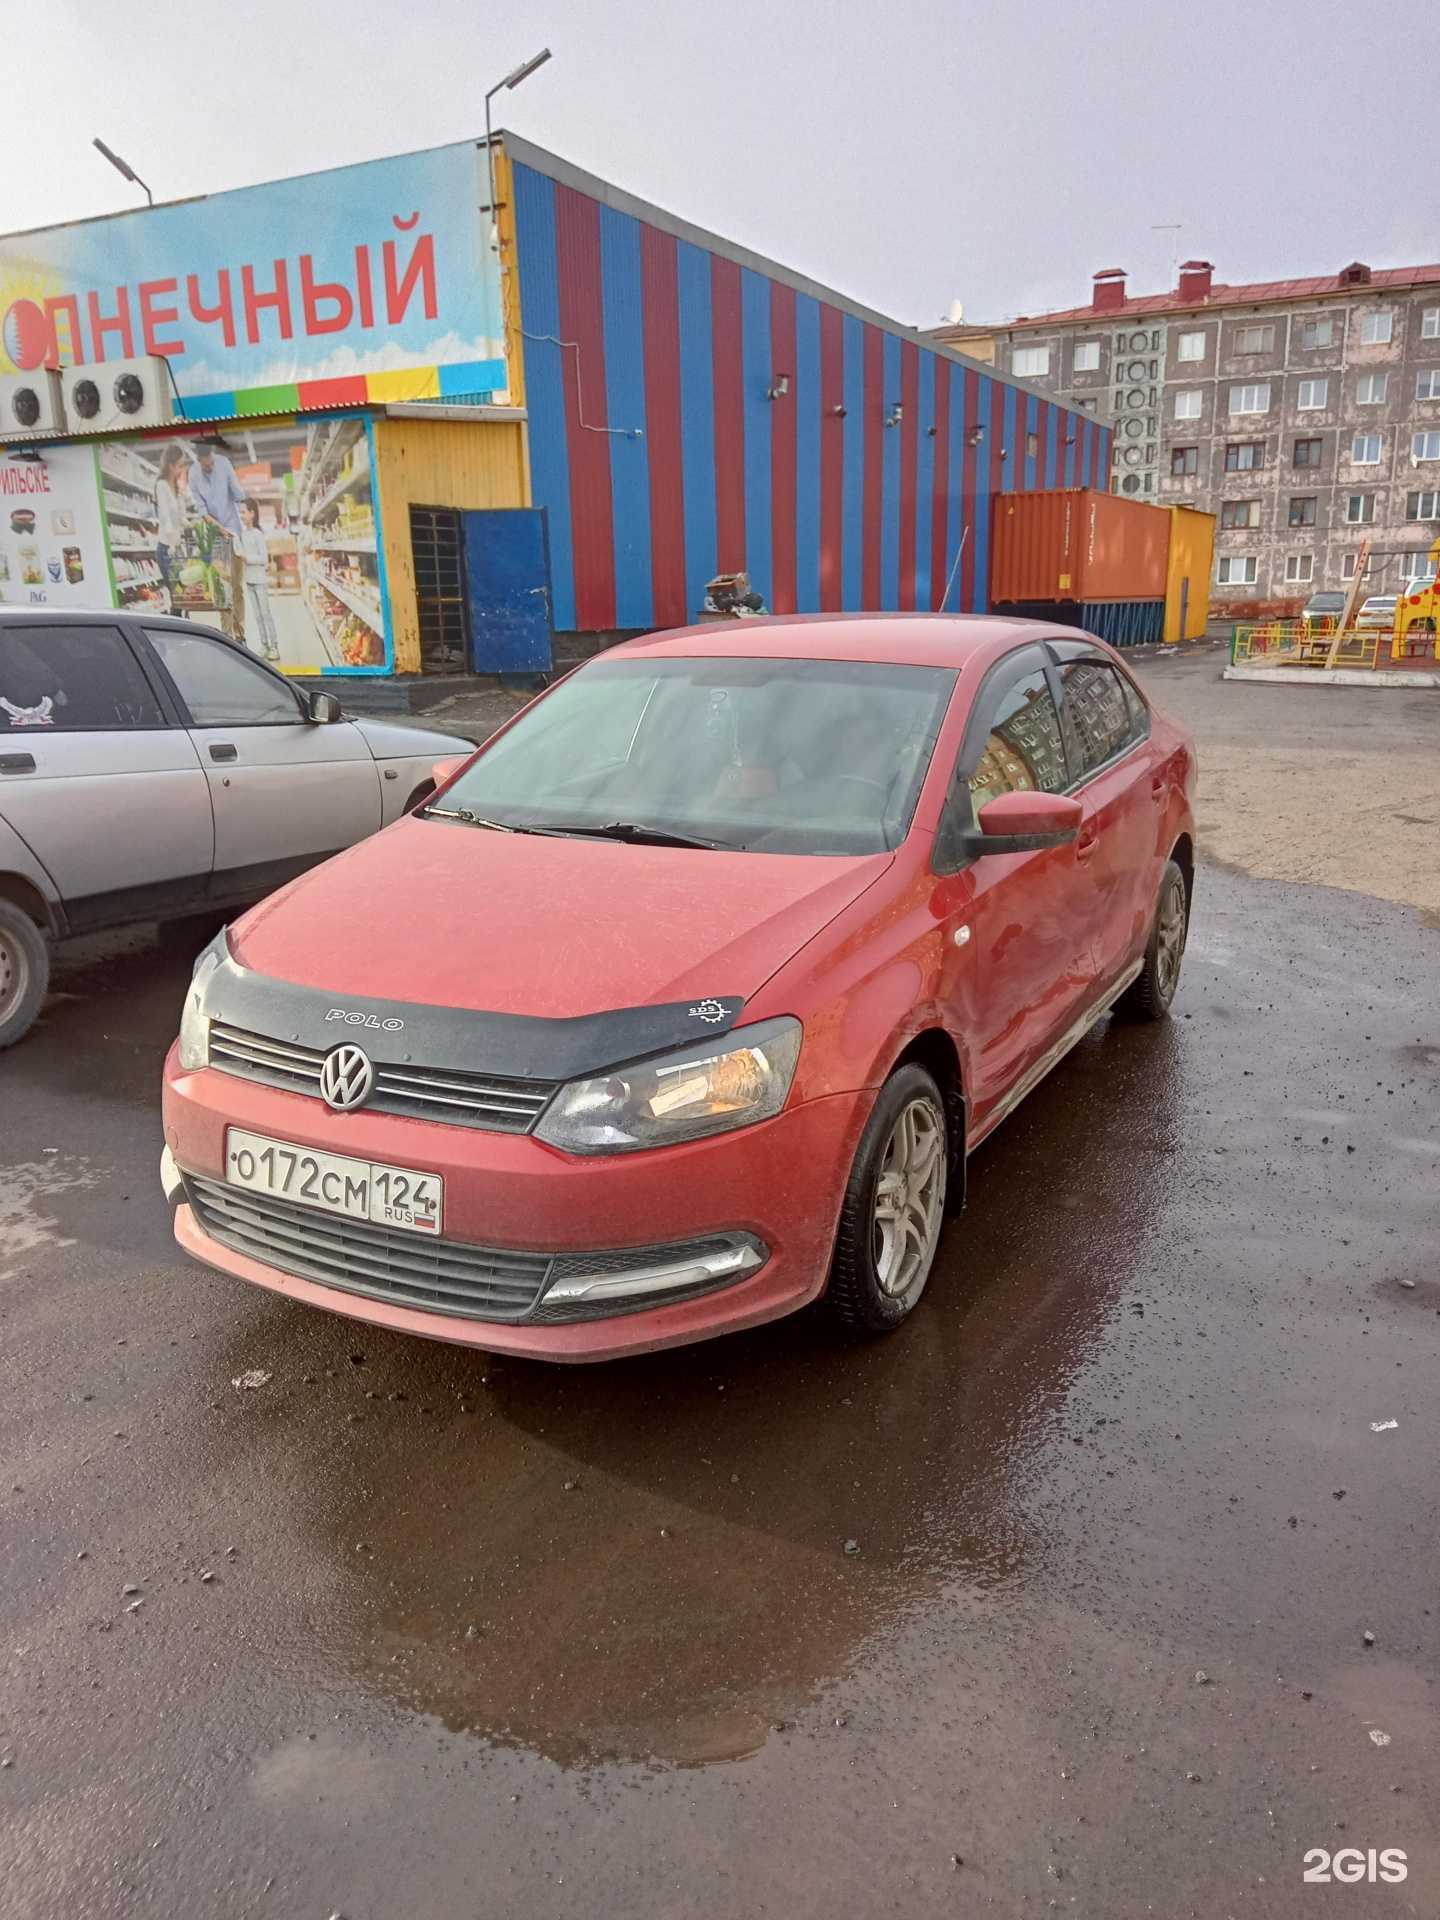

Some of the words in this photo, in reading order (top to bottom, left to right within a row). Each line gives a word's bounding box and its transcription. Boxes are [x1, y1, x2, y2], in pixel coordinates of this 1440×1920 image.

[0, 463, 50, 496] ИЛЬСКЕ
[325, 1009, 404, 1031] POLO
[689, 1005, 715, 1014] SDS
[375, 1172, 431, 1214] 124
[384, 1206, 413, 1223] RUS
